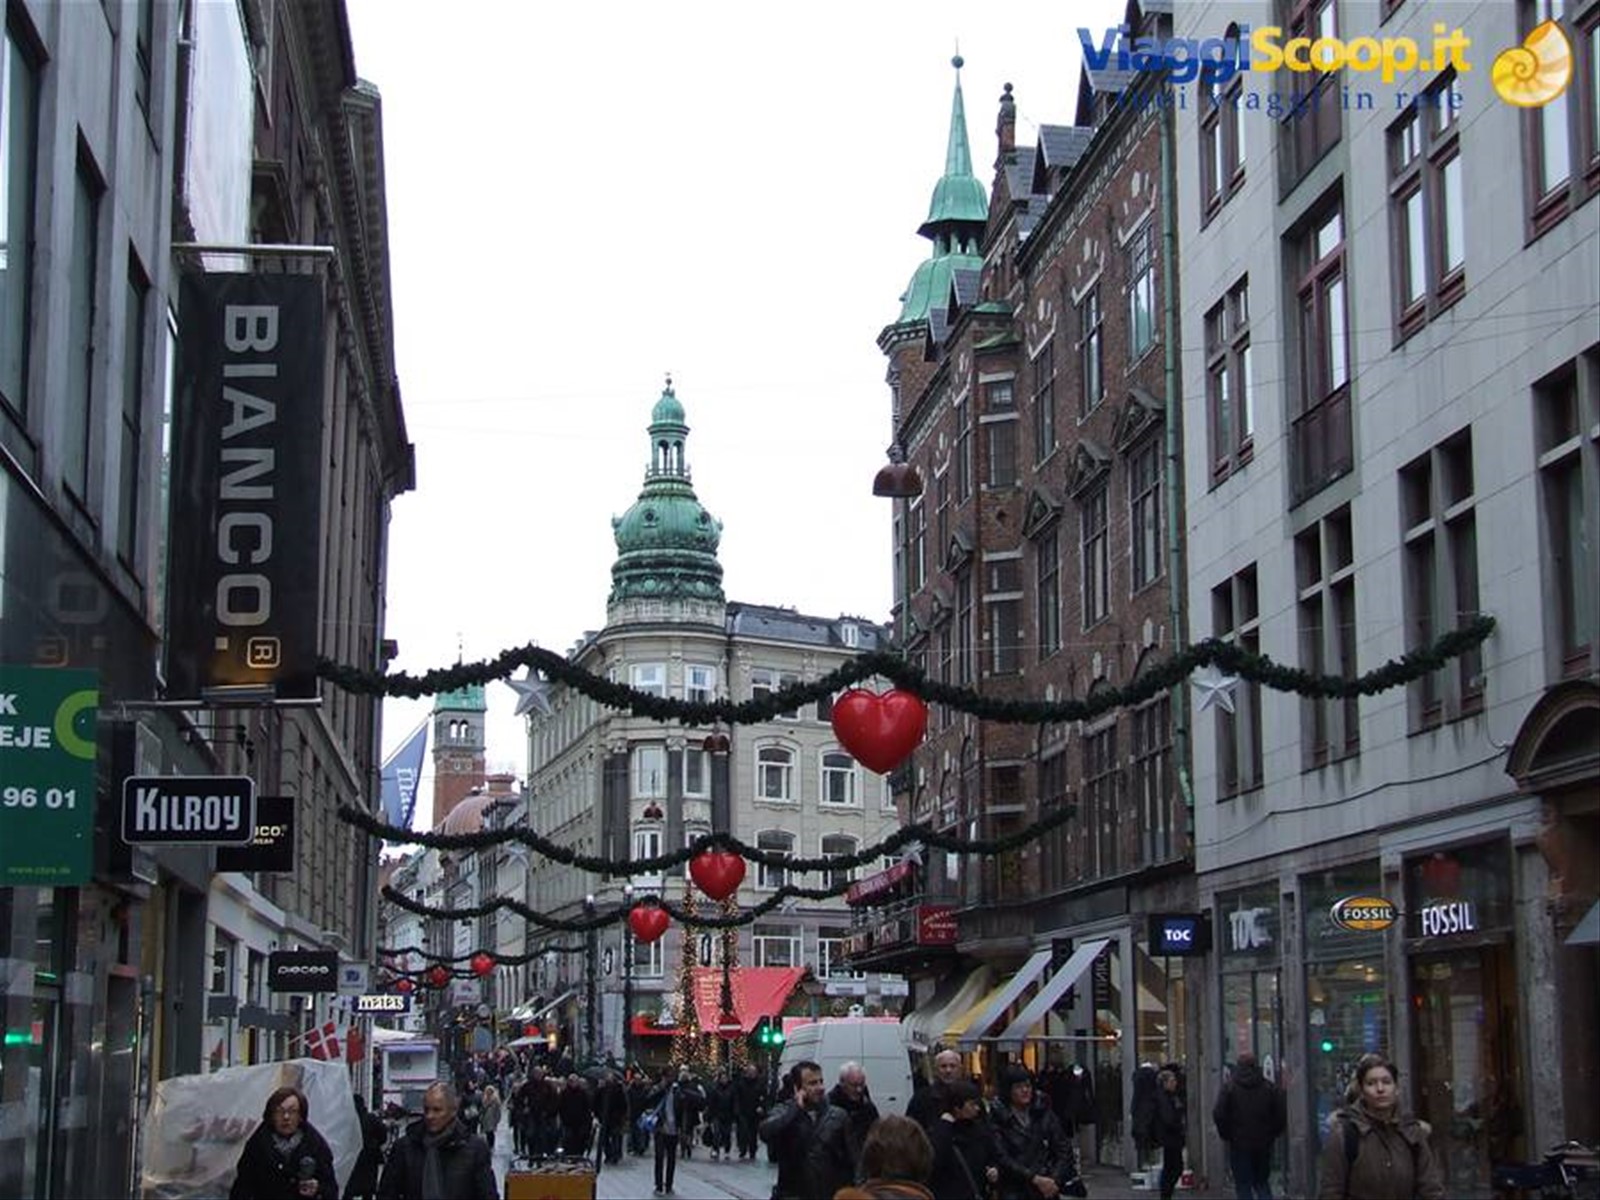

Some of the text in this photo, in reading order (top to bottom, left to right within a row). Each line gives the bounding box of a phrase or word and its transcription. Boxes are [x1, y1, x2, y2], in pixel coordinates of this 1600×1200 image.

[3, 787, 76, 809] 96 01
[135, 787, 240, 832] KILROY
[1343, 907, 1392, 921] FOSSIL
[1421, 901, 1474, 936] FOSSIL
[1164, 929, 1192, 941] TOC
[358, 993, 405, 1010] matas
